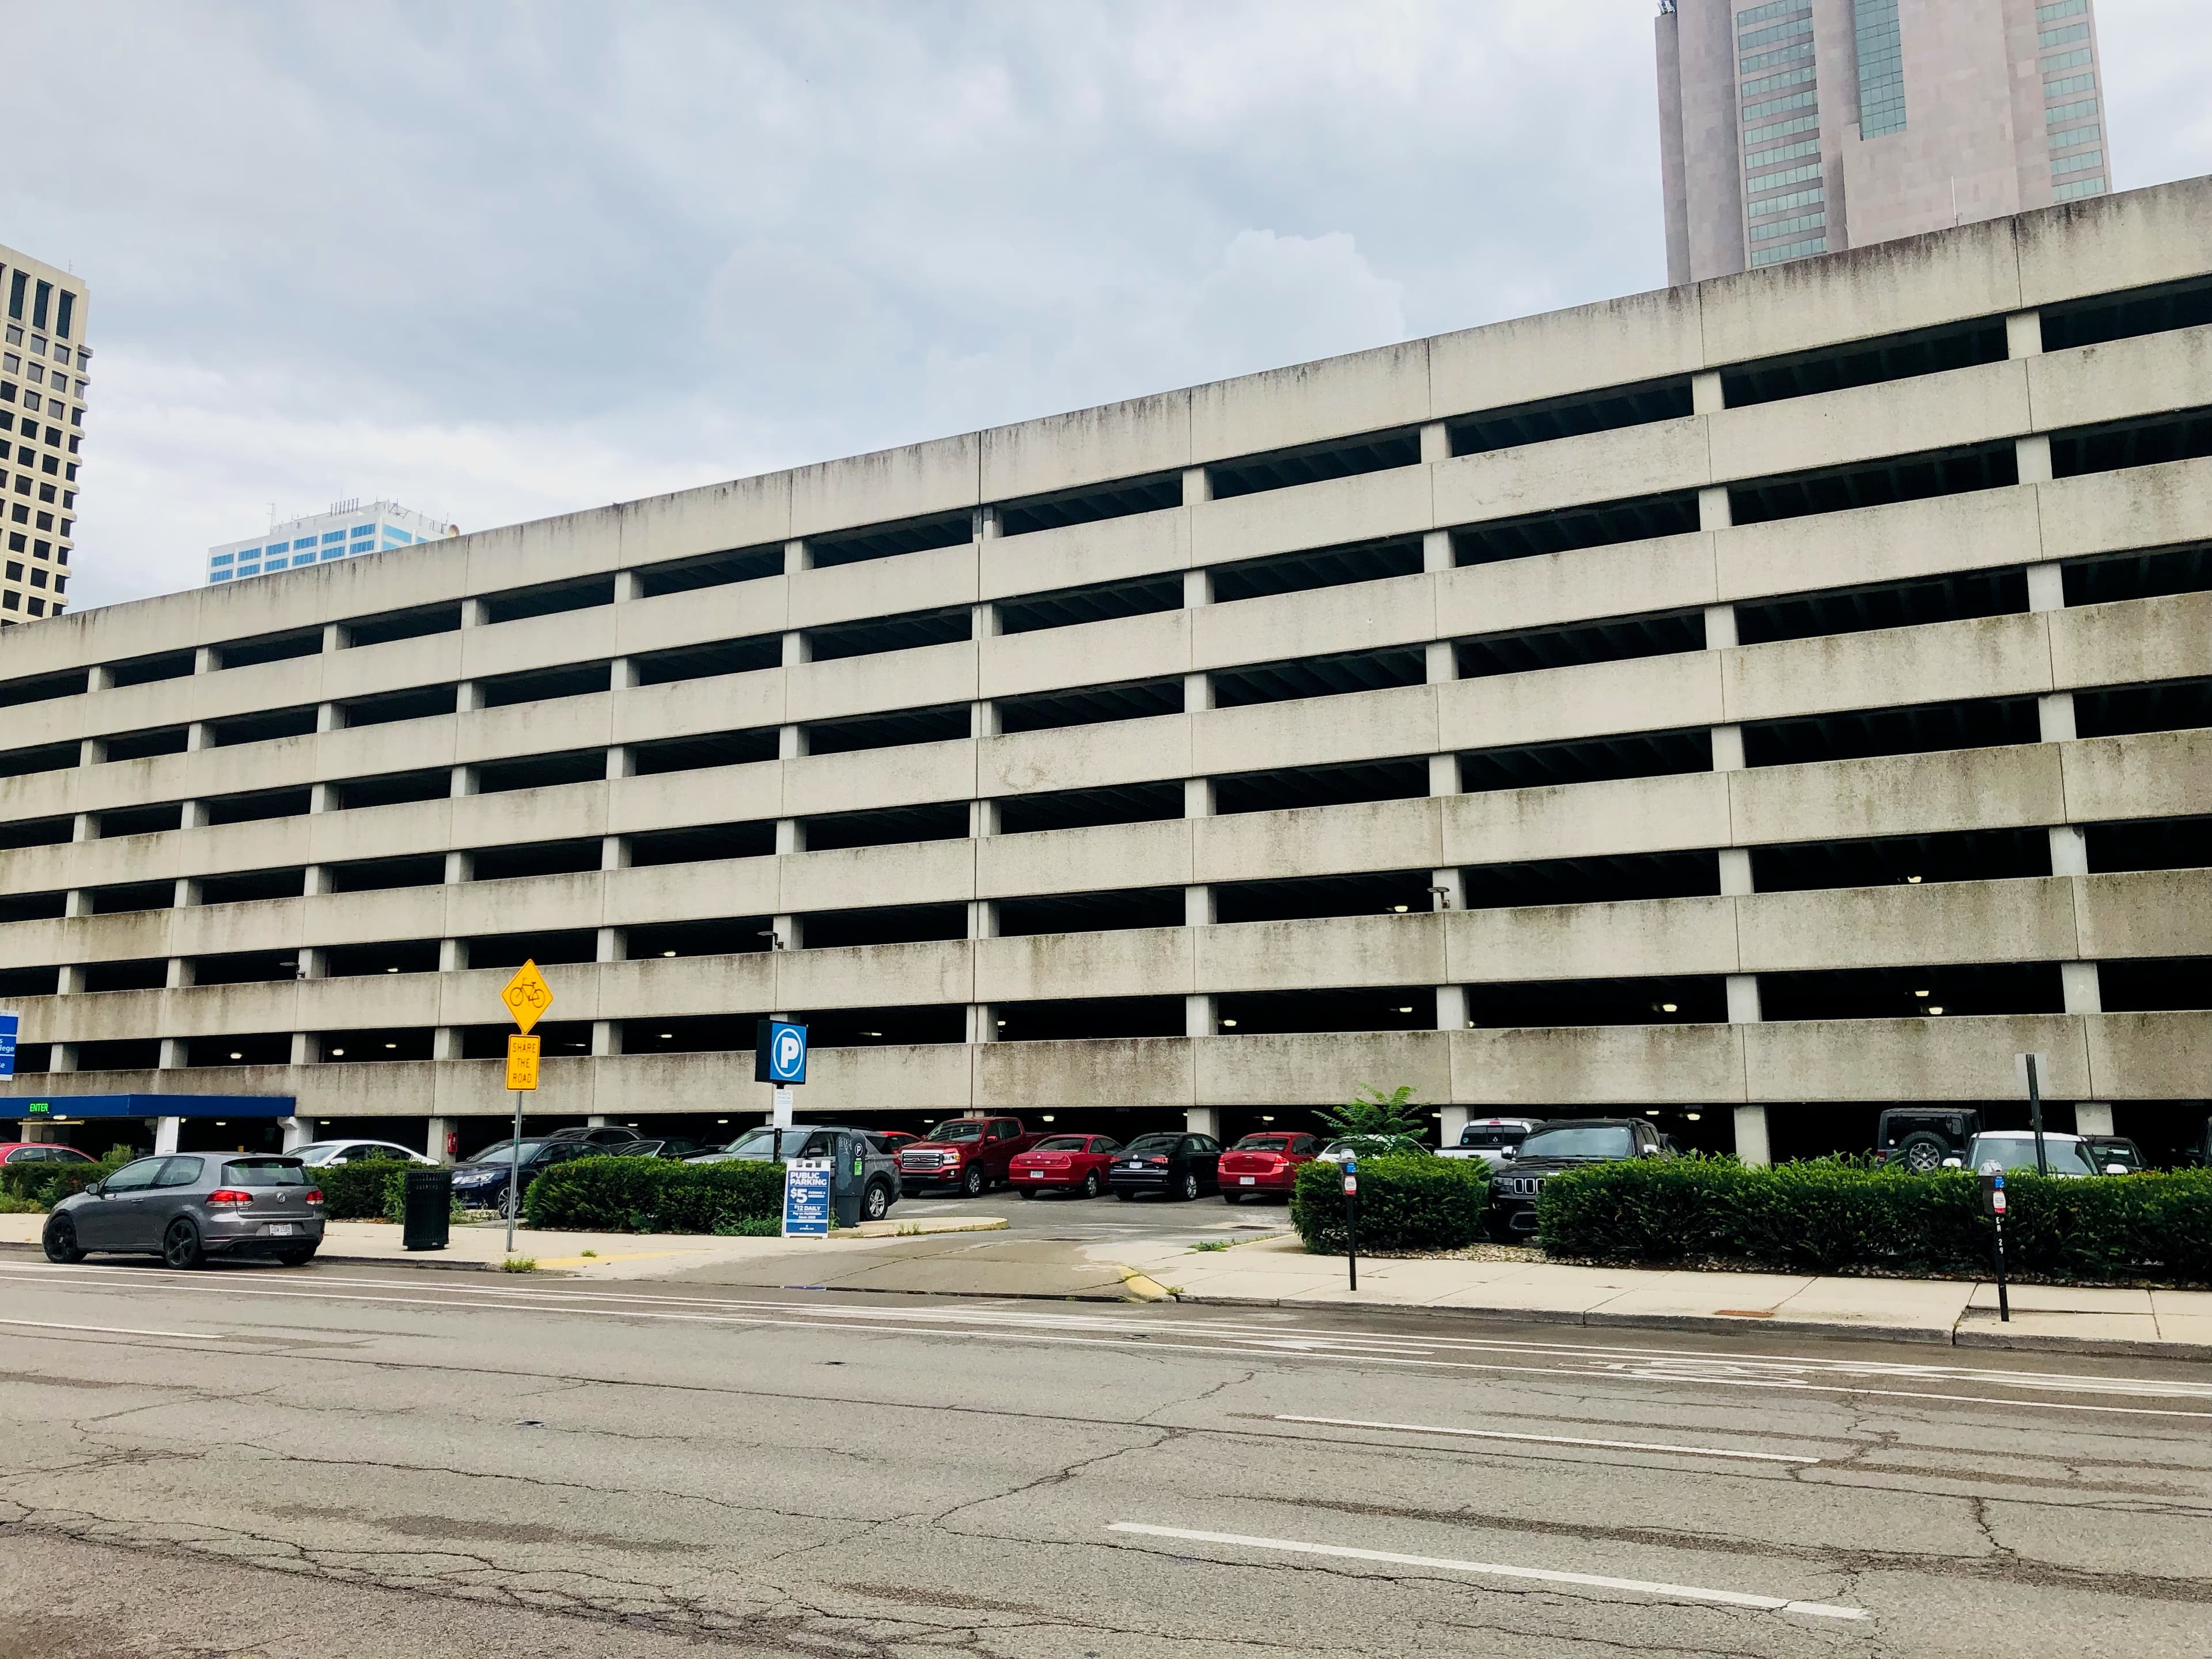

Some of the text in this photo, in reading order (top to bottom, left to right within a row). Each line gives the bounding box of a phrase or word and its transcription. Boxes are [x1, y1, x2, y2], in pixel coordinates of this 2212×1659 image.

[513, 1043, 536, 1054] SHARE
[781, 1036, 799, 1069] P
[517, 1058, 530, 1068] THE
[513, 1073, 532, 1084] ROAD
[29, 1103, 48, 1112] ENTER
[857, 1145, 861, 1154] P
[790, 1187, 808, 1203] $5
